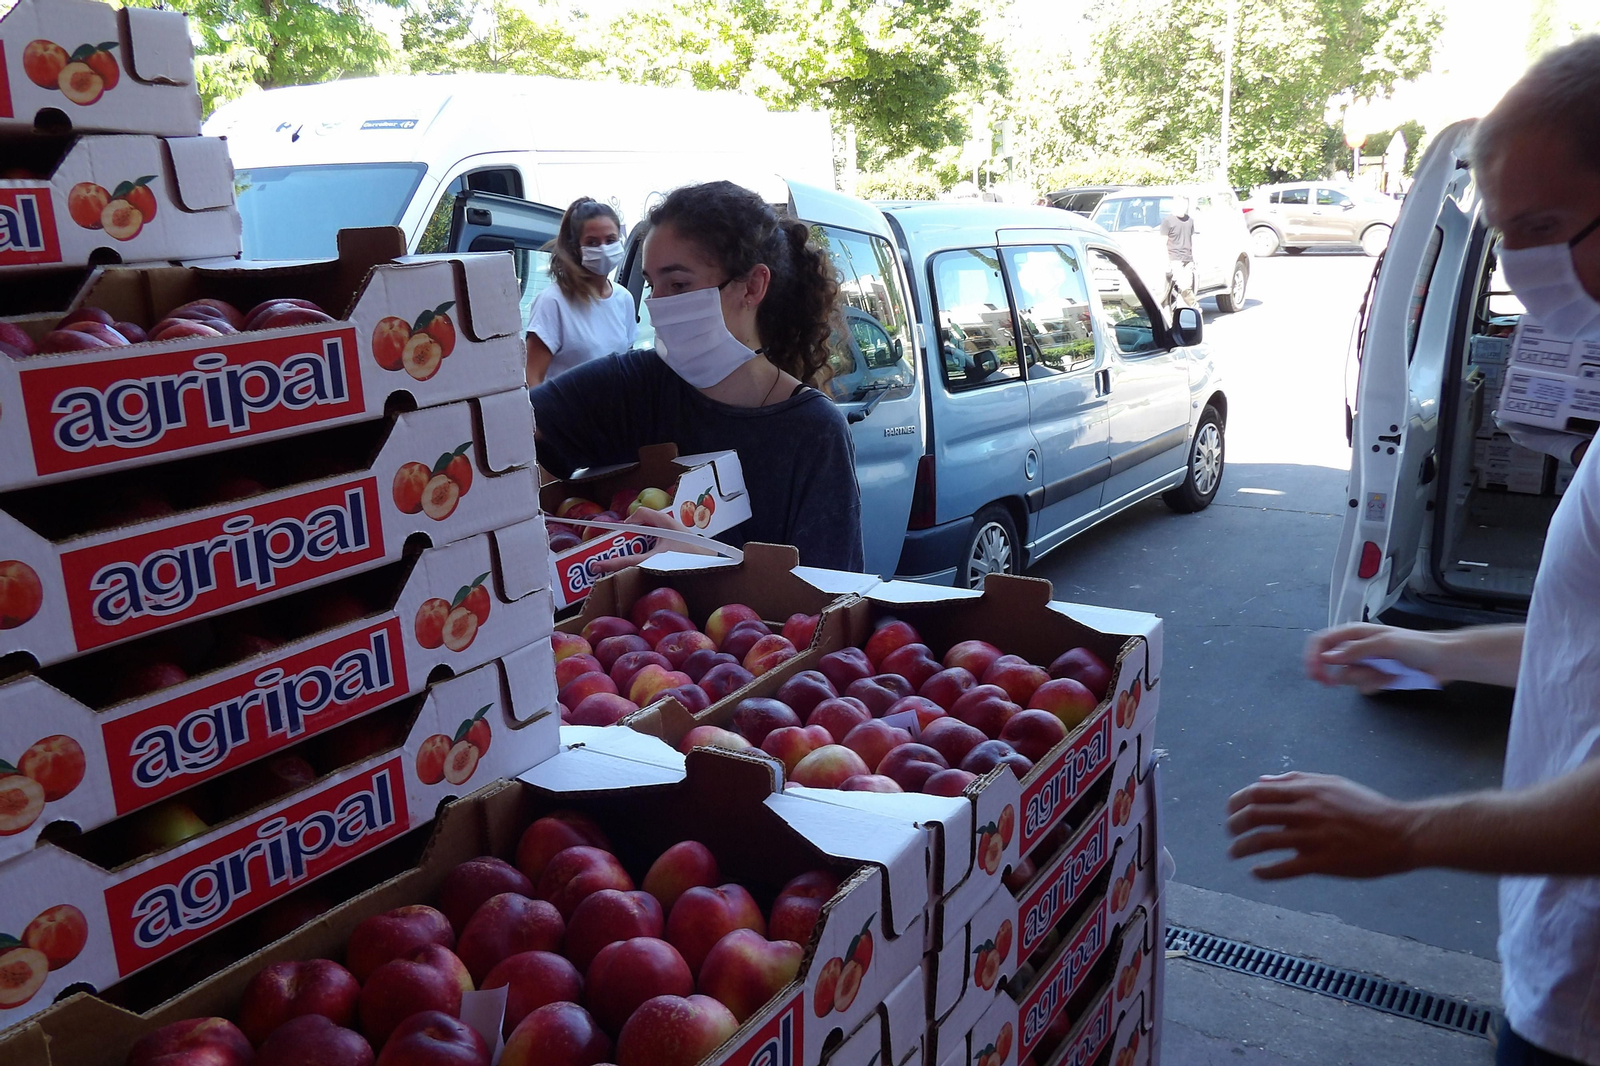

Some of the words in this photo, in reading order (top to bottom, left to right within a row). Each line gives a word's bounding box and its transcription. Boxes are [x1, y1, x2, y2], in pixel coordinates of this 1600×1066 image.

[50, 337, 350, 453] agripal
[884, 425, 916, 438] PARTNER
[90, 487, 371, 627] agripal
[129, 629, 396, 788] agripal
[1024, 714, 1108, 838] agripal
[131, 768, 396, 949] agripal
[1023, 818, 1104, 948] agripal
[1022, 913, 1102, 1046] agripal
